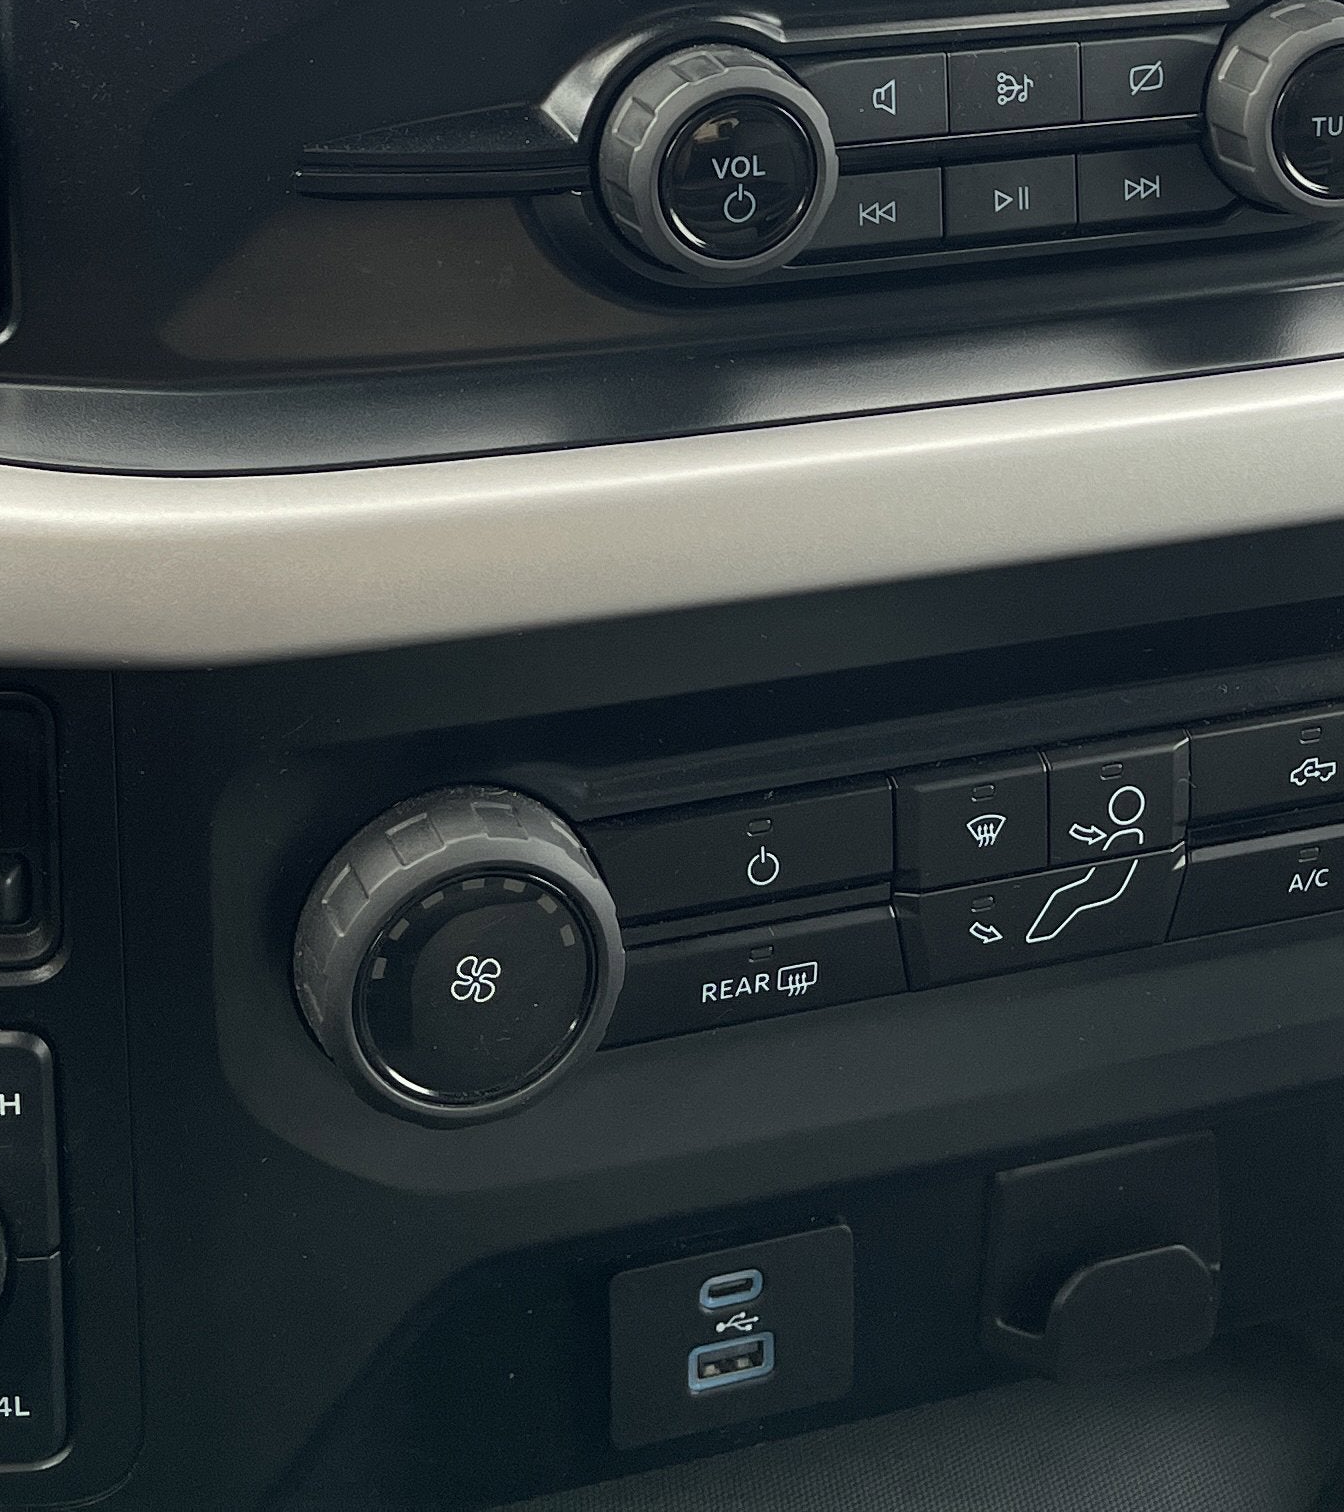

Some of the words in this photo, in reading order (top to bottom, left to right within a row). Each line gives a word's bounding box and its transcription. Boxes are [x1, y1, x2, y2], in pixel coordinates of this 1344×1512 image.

[711, 157, 767, 181] VOL
[1288, 867, 1329, 894] A/C
[702, 973, 770, 1003] REAR
